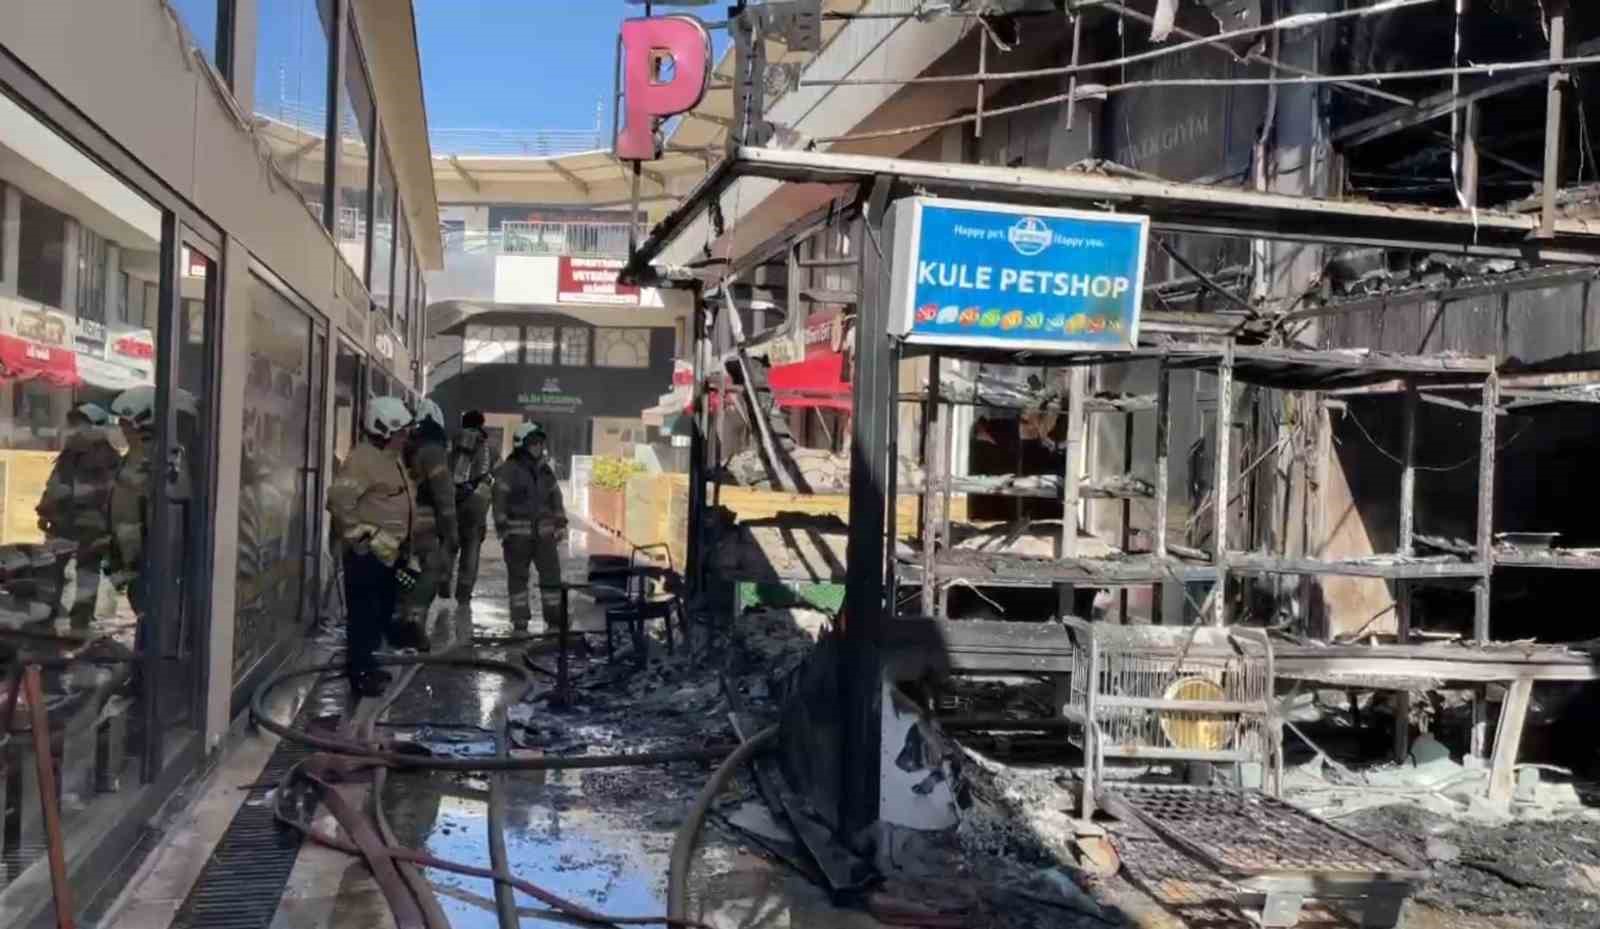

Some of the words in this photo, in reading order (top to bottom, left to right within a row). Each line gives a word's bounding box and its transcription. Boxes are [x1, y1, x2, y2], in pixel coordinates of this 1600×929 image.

[616, 15, 711, 160] P
[954, 224, 984, 239] Happy
[1054, 234, 1084, 248] Happy
[918, 260, 992, 290] KULE
[1000, 268, 1129, 299] PETSHOP
